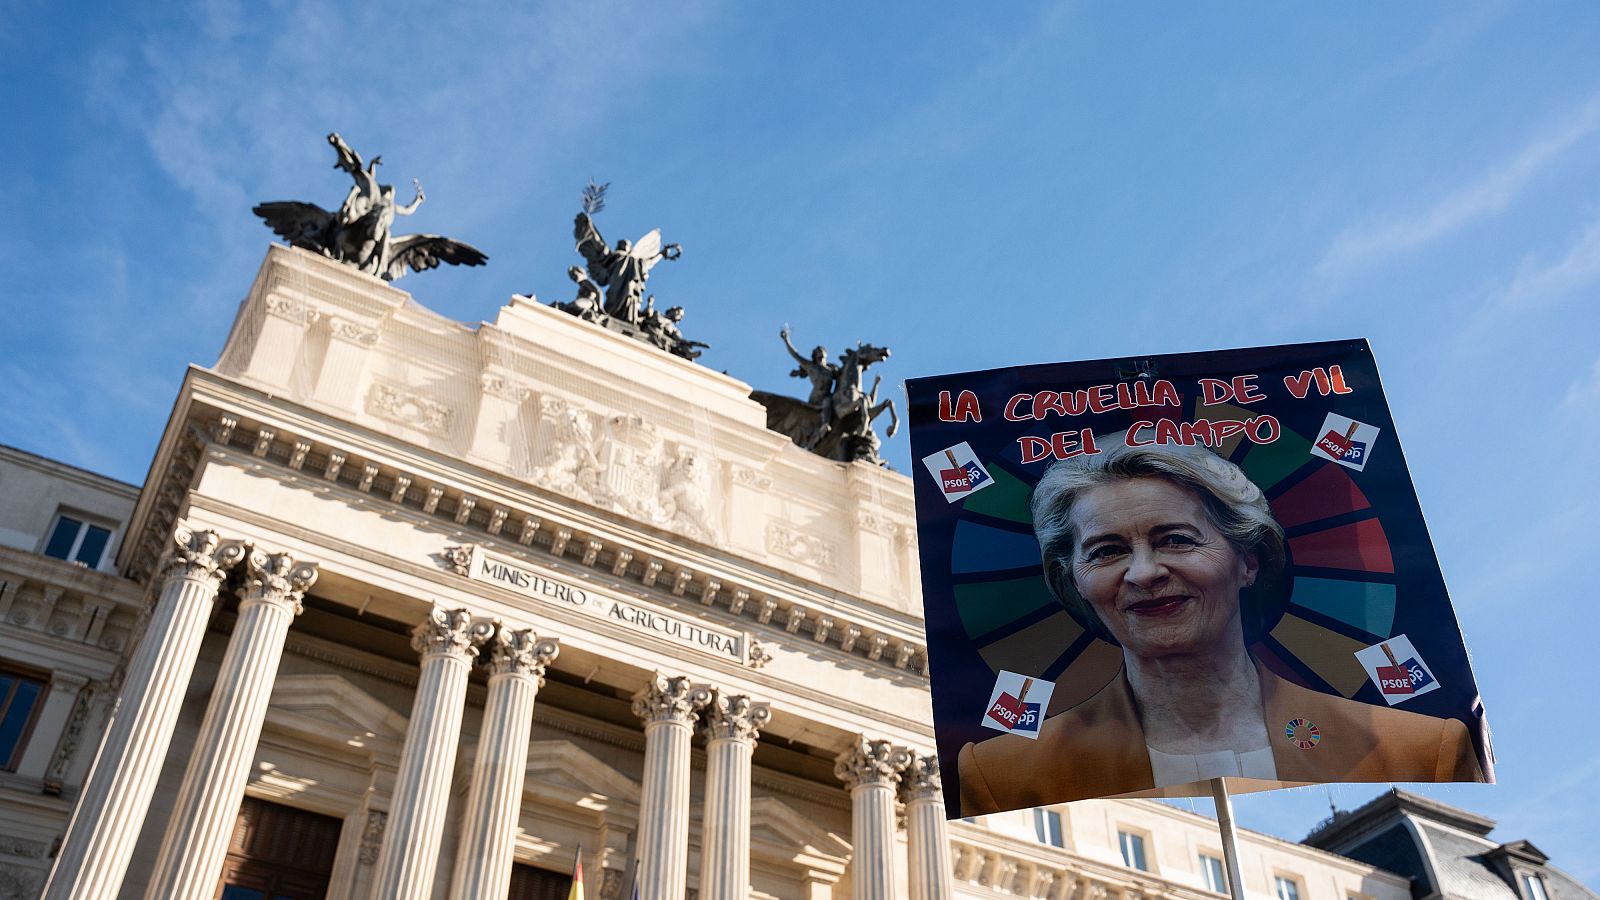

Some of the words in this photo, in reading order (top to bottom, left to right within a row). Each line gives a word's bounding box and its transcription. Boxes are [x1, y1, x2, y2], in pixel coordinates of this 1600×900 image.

[938, 390, 982, 423] LA
[1004, 380, 1184, 421] CRUELLA
[1198, 375, 1266, 405] DE
[1284, 365, 1352, 398] VIL
[1017, 428, 1101, 464] DEL
[1125, 415, 1280, 448] CAMPO
[1320, 438, 1345, 456] PSOE
[944, 477, 969, 489] PSOE
[481, 560, 587, 607] MINISTERIO
[608, 602, 735, 656] AGRICULTURA
[1381, 678, 1411, 689] PSOE
[992, 703, 1018, 724] PSOE
